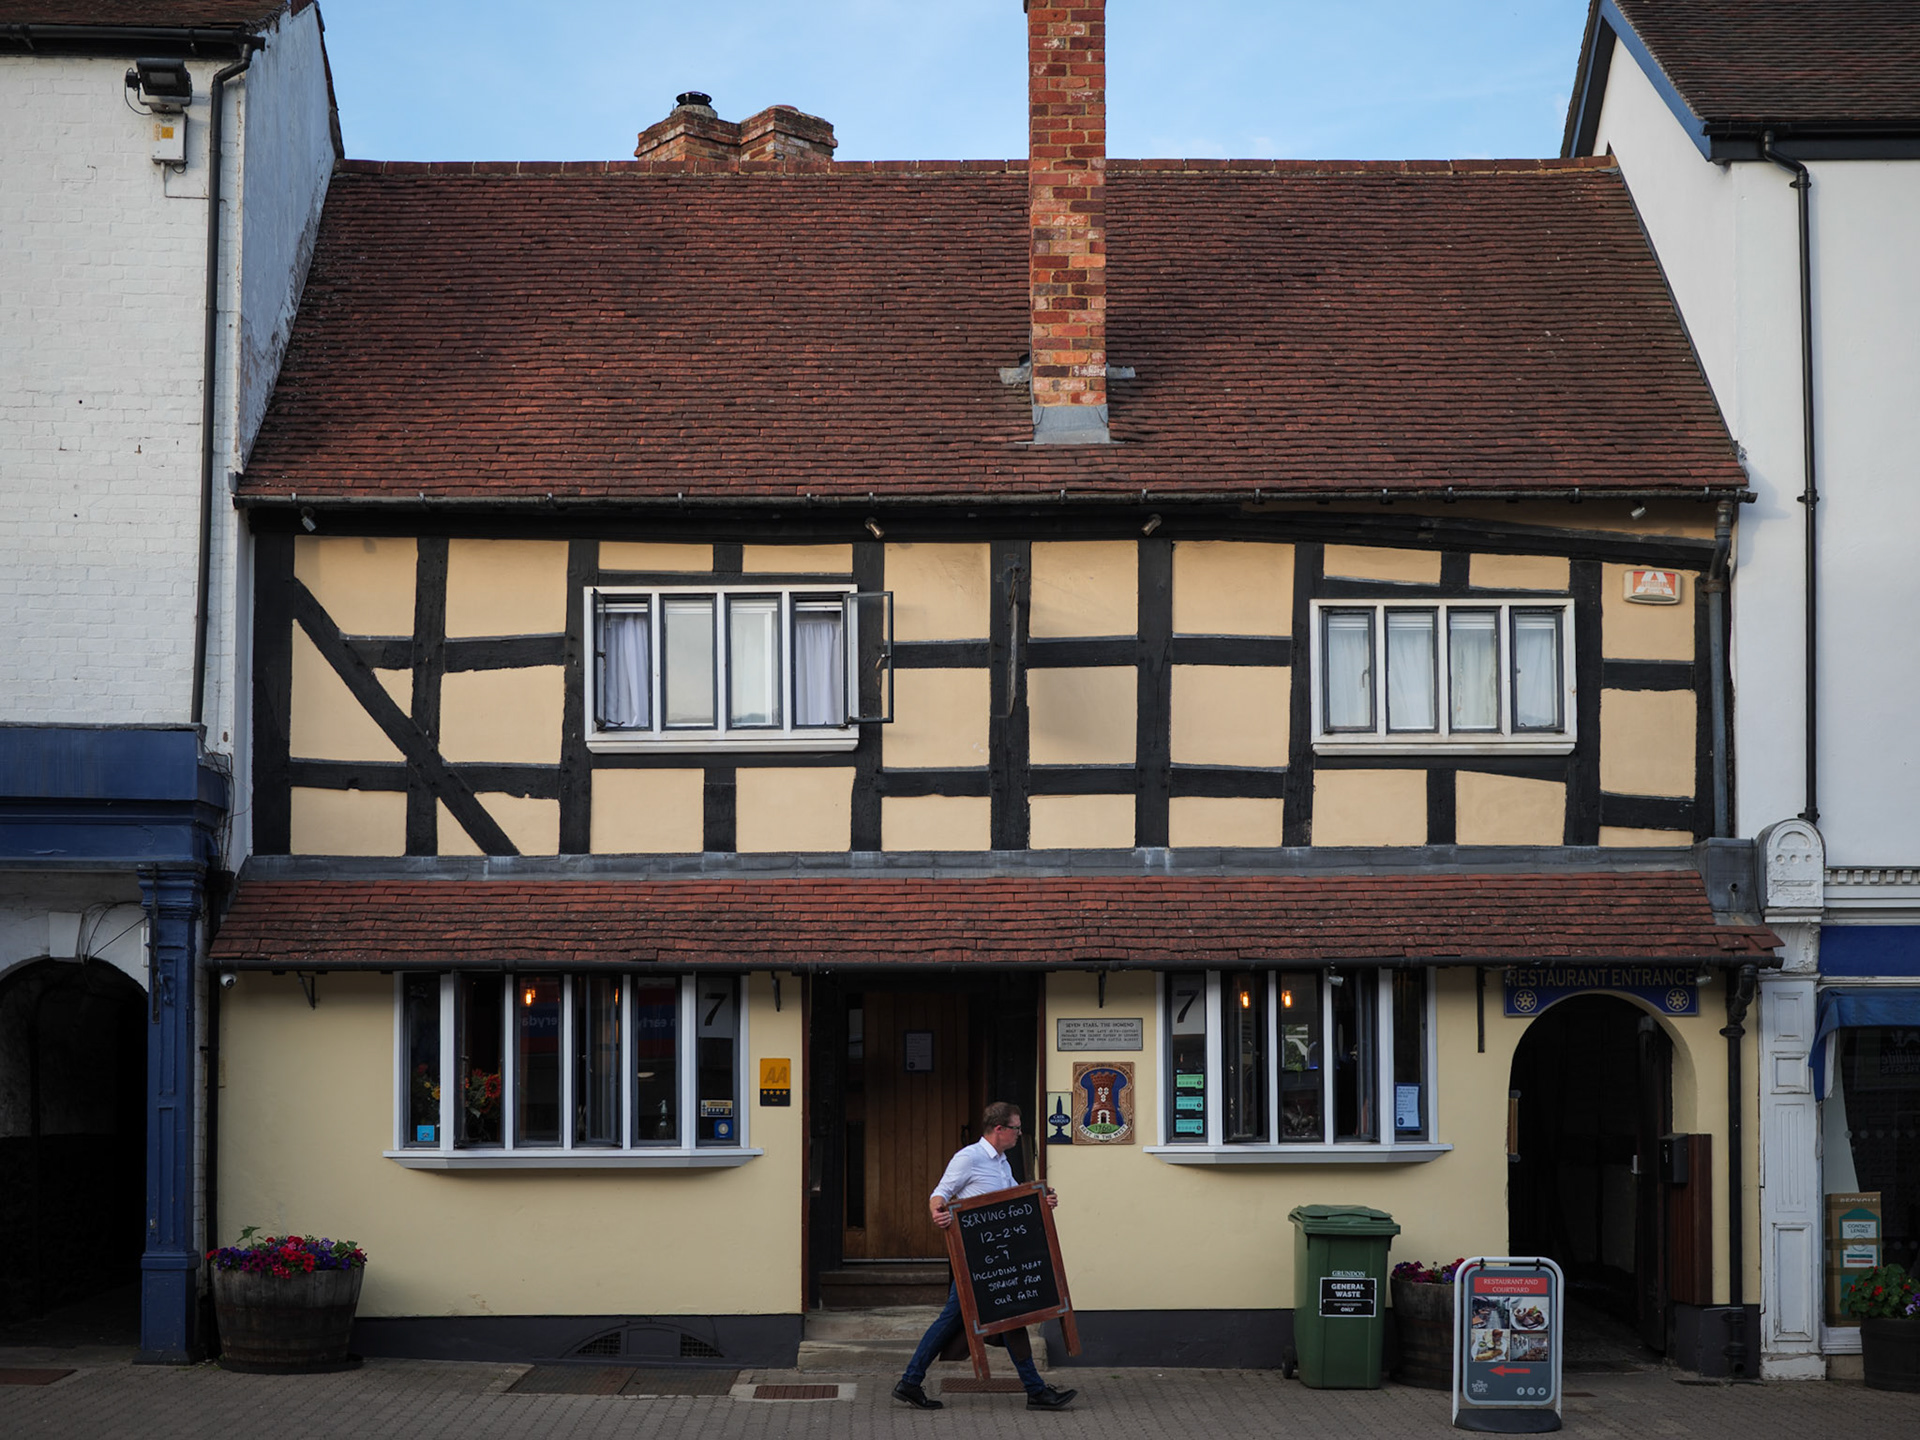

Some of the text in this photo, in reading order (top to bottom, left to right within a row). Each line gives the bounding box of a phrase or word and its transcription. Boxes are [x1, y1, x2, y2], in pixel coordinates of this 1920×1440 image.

[1509, 968, 1695, 987] RESTAURANT ENTRANCE
[704, 992, 728, 1027] 7
[1177, 990, 1200, 1024] 7
[764, 1066, 787, 1084] AA
[1113, 1126, 1127, 1137] WEST
[961, 1210, 1006, 1228] SERVING
[1021, 1261, 1042, 1270] MEAT
